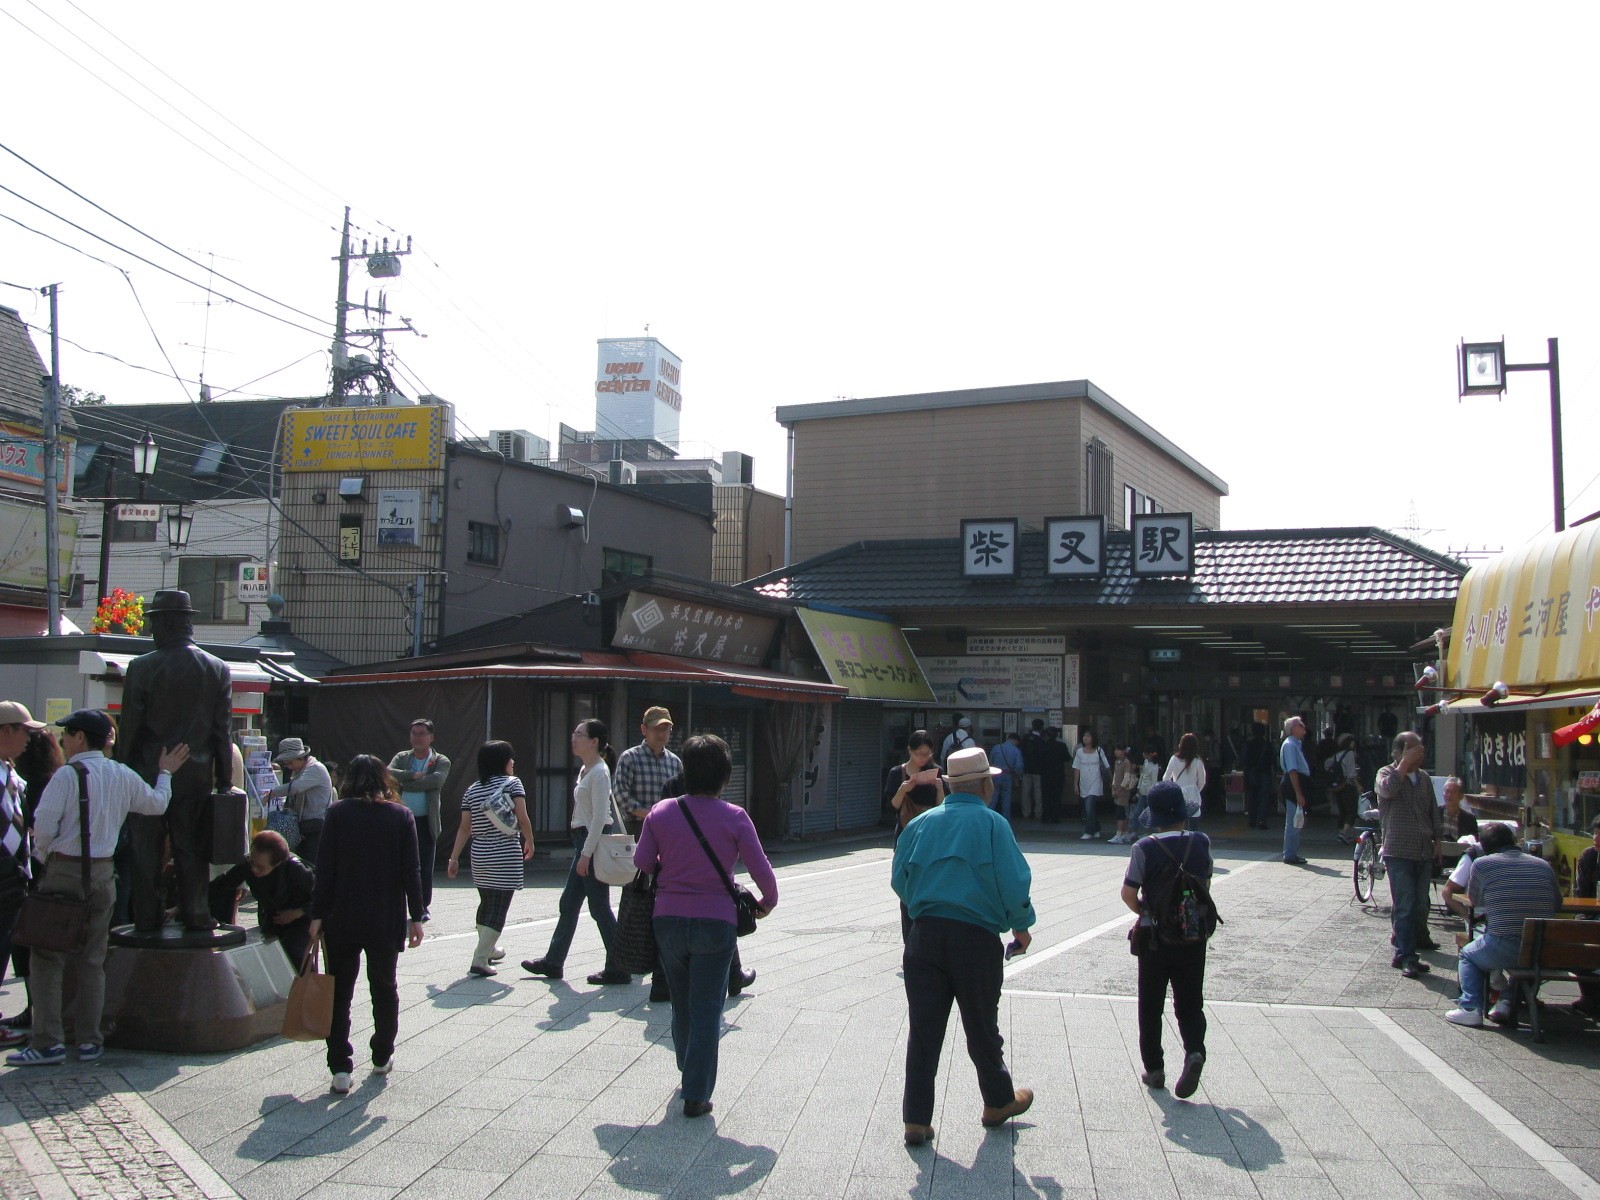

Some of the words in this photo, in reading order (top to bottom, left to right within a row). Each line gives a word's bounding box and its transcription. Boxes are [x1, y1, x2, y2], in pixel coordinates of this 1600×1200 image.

[597, 380, 651, 393] CENTER
[655, 380, 682, 411] CENTER
[323, 413, 342, 423] CAFE
[351, 412, 399, 421] RESTAURANT
[304, 424, 349, 442] SWEET
[350, 423, 382, 440] SOUL
[385, 421, 418, 439] CAFE
[326, 450, 352, 459] LUNCH
[361, 450, 394, 458] DINNER
[341, 536, 350, 558] ケーキ
[351, 528, 359, 556] コーヒー
[1464, 604, 1508, 654] 今川焼
[1518, 590, 1571, 639] 三河屋
[834, 658, 920, 684] 柴又コーヒースタンド
[1483, 731, 1526, 767] やきそば
